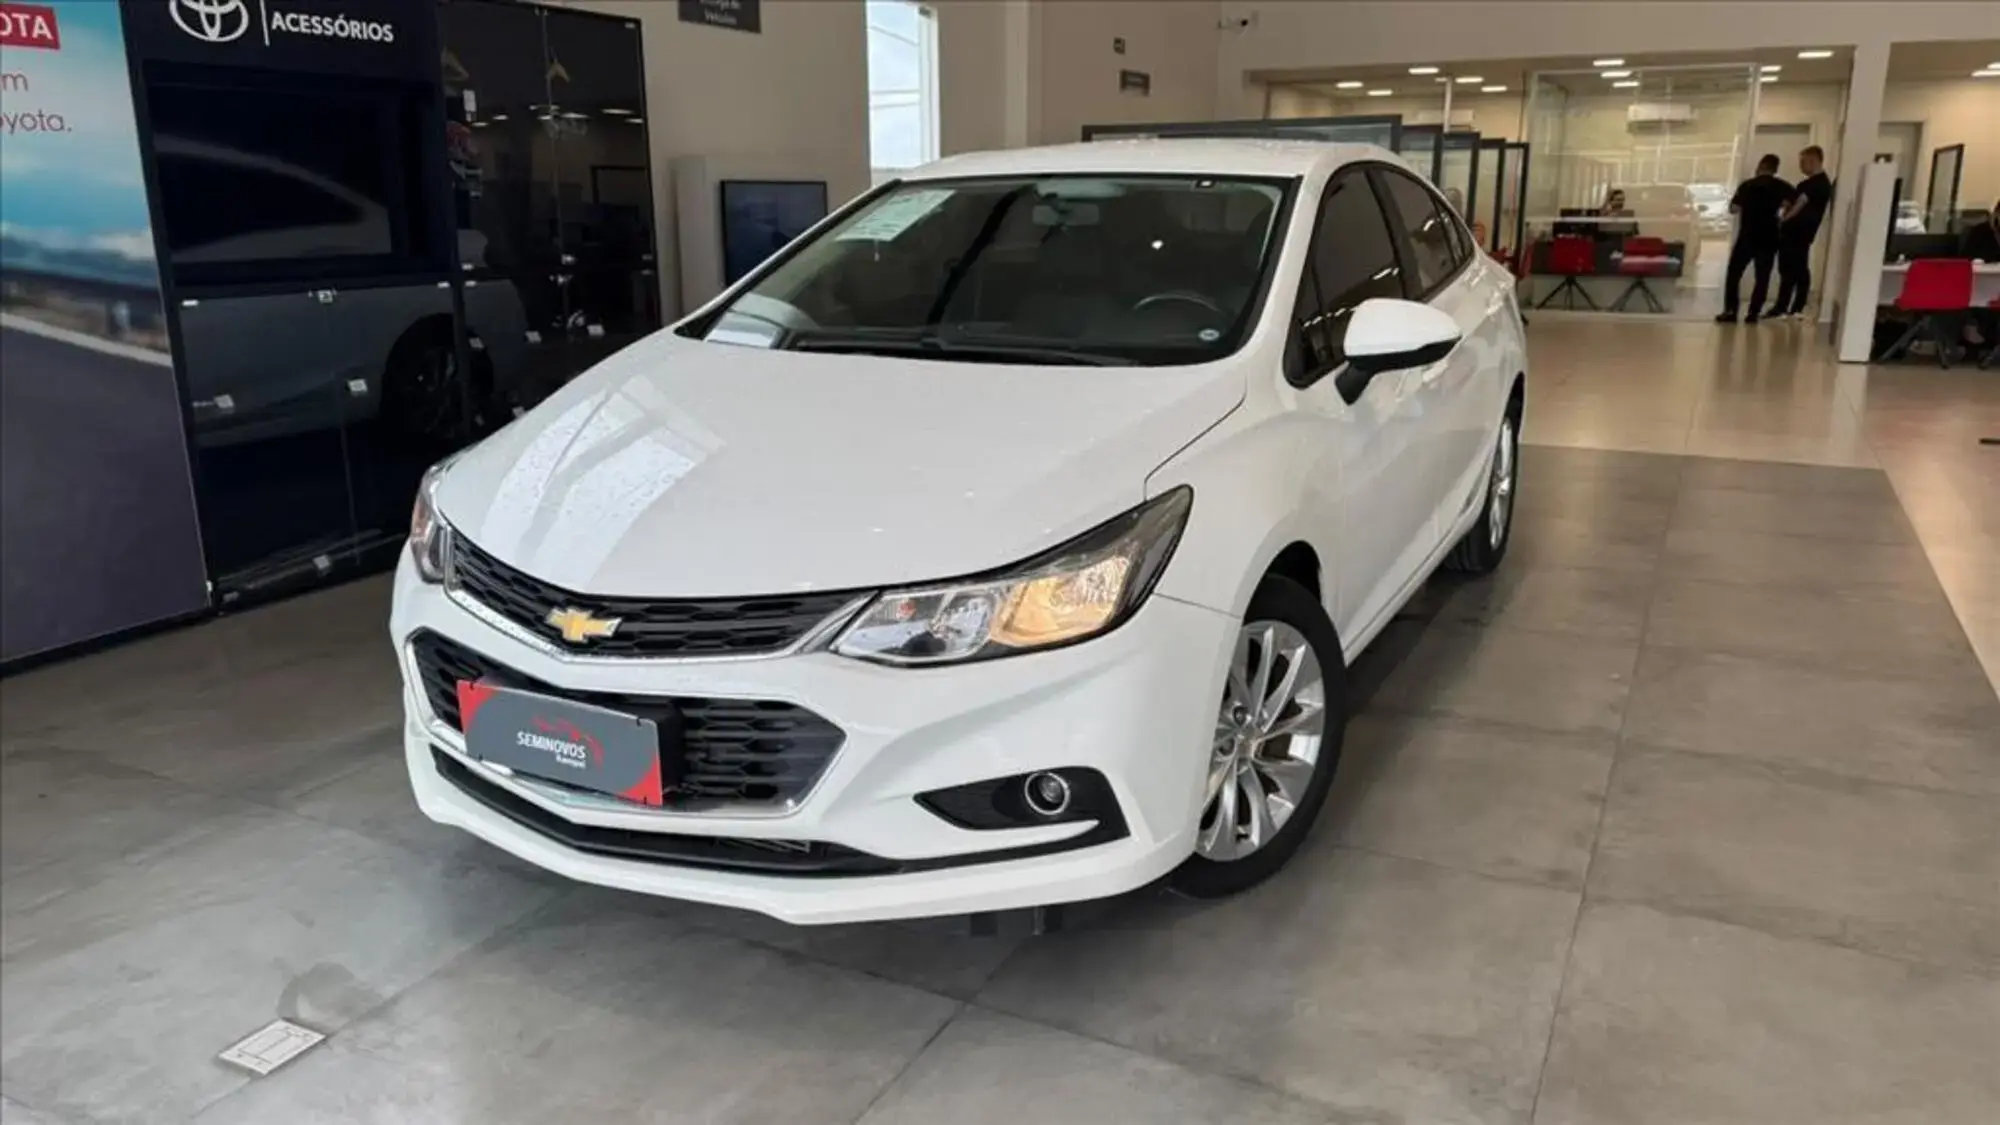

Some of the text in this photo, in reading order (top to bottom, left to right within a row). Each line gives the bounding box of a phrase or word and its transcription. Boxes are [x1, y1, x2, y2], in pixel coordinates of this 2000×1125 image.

[271, 11, 394, 42] ACESSÓRIOS
[0, 109, 72, 136] yota.
[516, 731, 586, 759] SEMINOVOS
